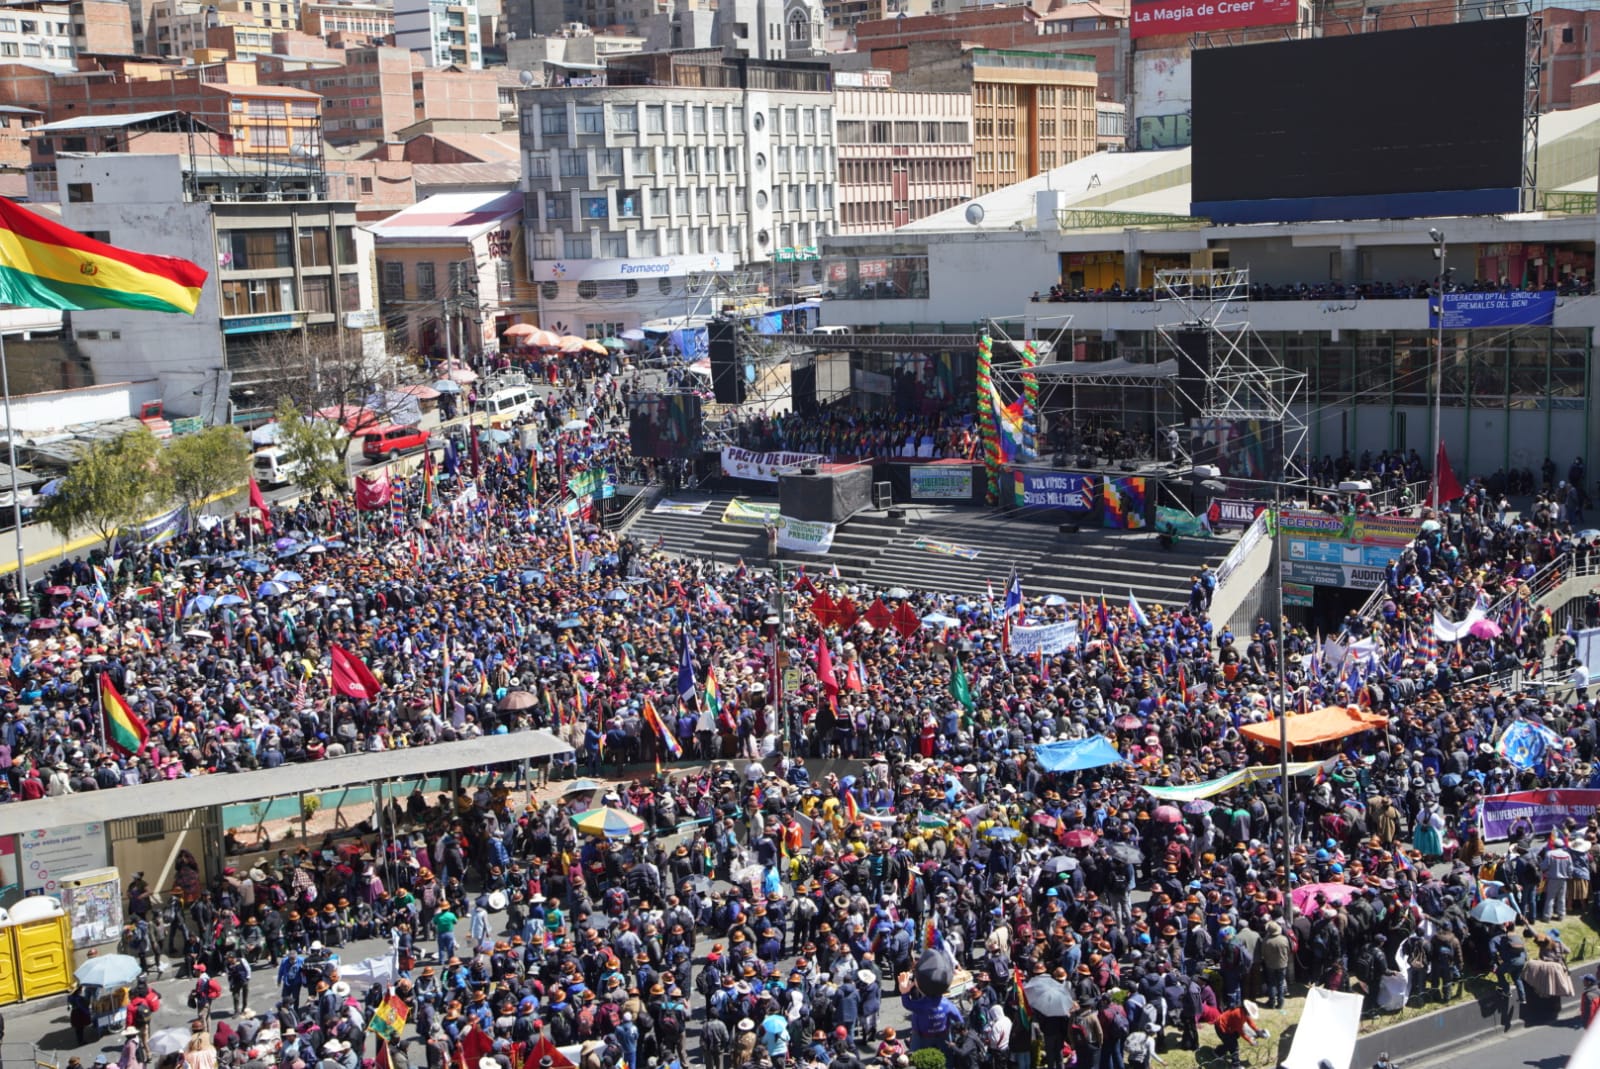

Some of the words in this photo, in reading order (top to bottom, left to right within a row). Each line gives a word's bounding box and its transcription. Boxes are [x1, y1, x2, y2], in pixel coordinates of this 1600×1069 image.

[1134, 11, 1150, 22] La
[1154, 5, 1194, 21] Magia
[1197, 5, 1214, 17] de
[1218, 1, 1255, 14] Creer
[621, 263, 670, 275] Farmacorp
[1510, 291, 1541, 300] SINDICAL
[1457, 301, 1495, 309] GREMIALES
[728, 447, 765, 464] PACTO
[766, 453, 780, 466] DE
[1070, 478, 1075, 490] Y
[1047, 492, 1083, 507] MILLONES
[1221, 504, 1254, 520] WILAS
[1486, 806, 1534, 821] UNIVERSIDAD
